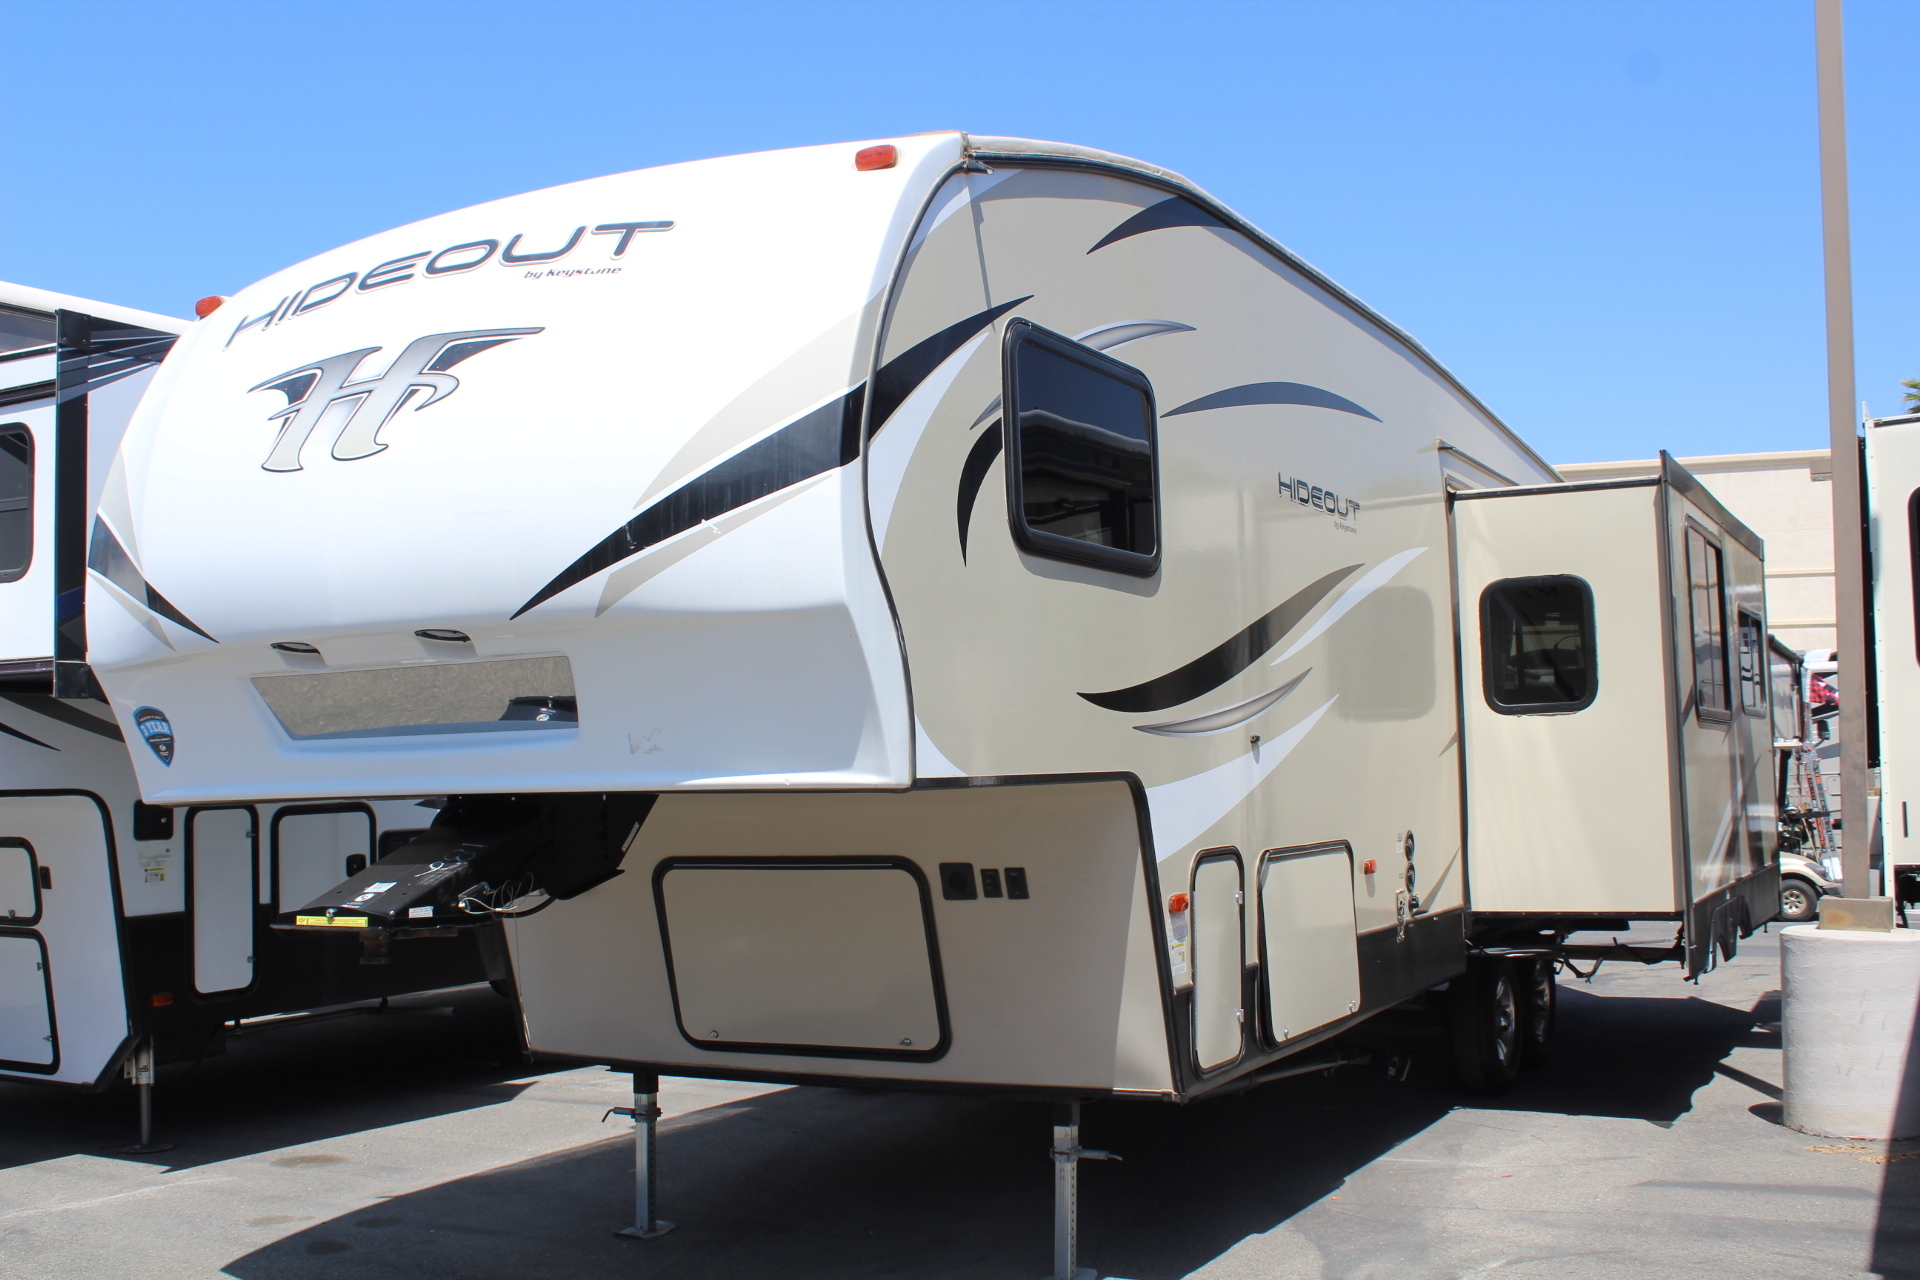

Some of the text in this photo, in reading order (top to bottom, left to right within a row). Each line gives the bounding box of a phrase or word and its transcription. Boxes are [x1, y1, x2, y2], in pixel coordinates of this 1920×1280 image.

[223, 219, 676, 351] HIDEOUT
[524, 270, 544, 280] by
[1278, 472, 1360, 522] HIDEOUT
[145, 721, 170, 733] YEAR
